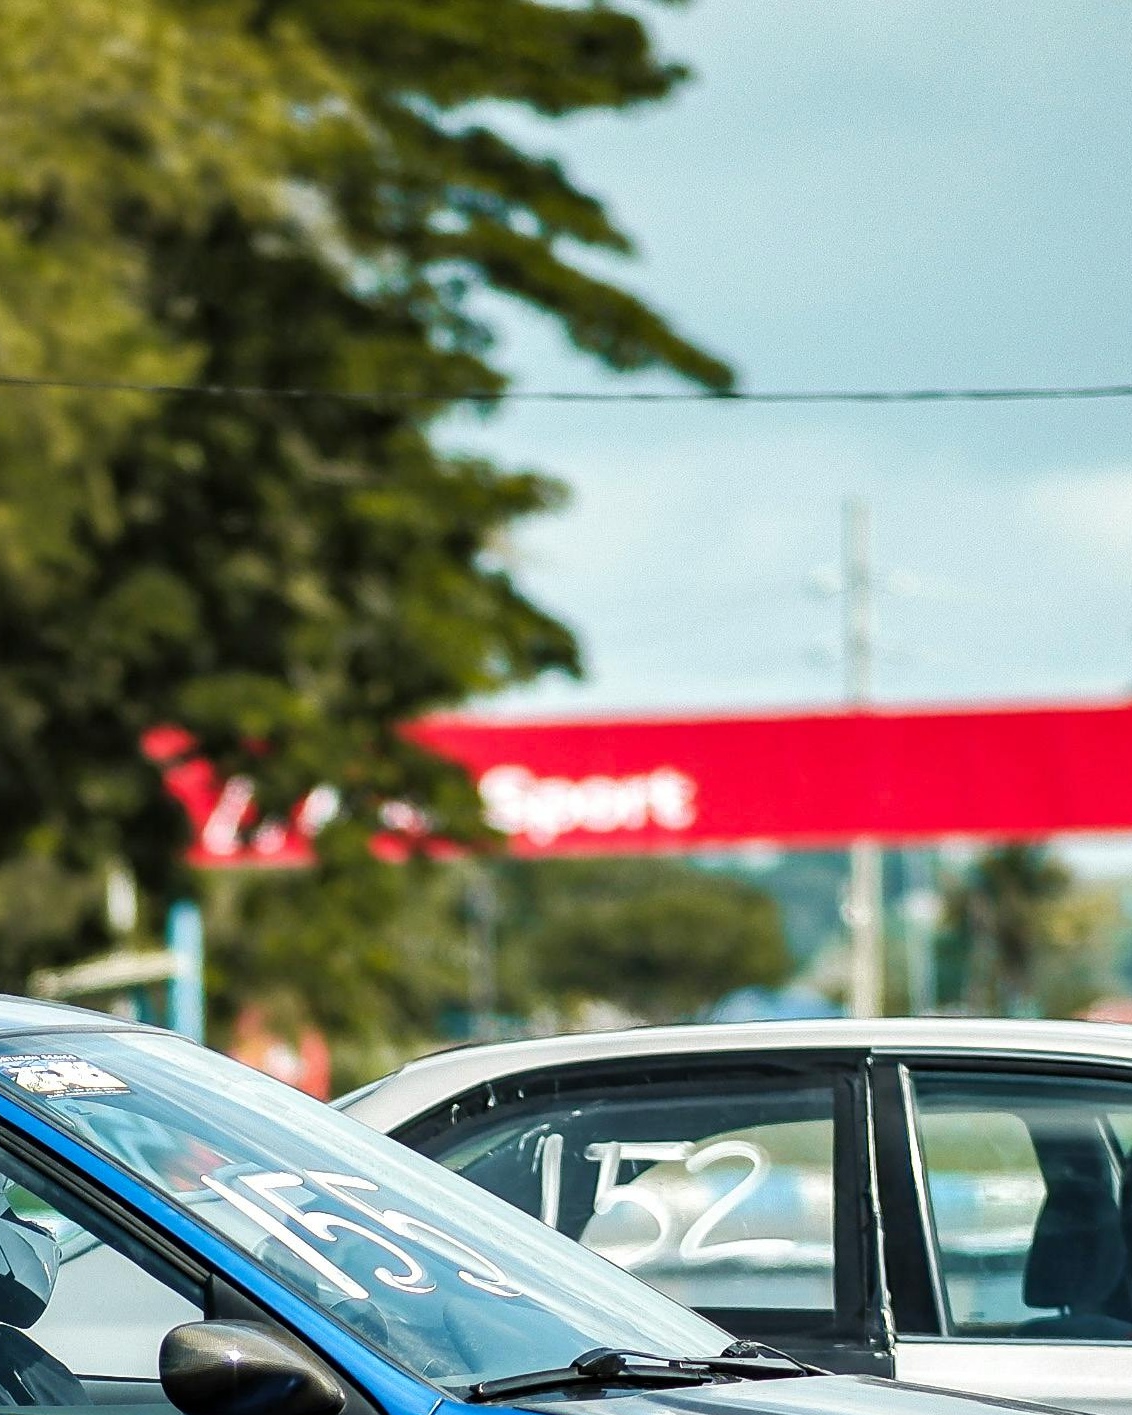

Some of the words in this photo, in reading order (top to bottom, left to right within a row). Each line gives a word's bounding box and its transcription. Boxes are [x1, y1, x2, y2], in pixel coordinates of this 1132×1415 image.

[479, 767, 695, 847] Sport
[201, 1169, 522, 1300] 155
[532, 1133, 797, 1268] 152
